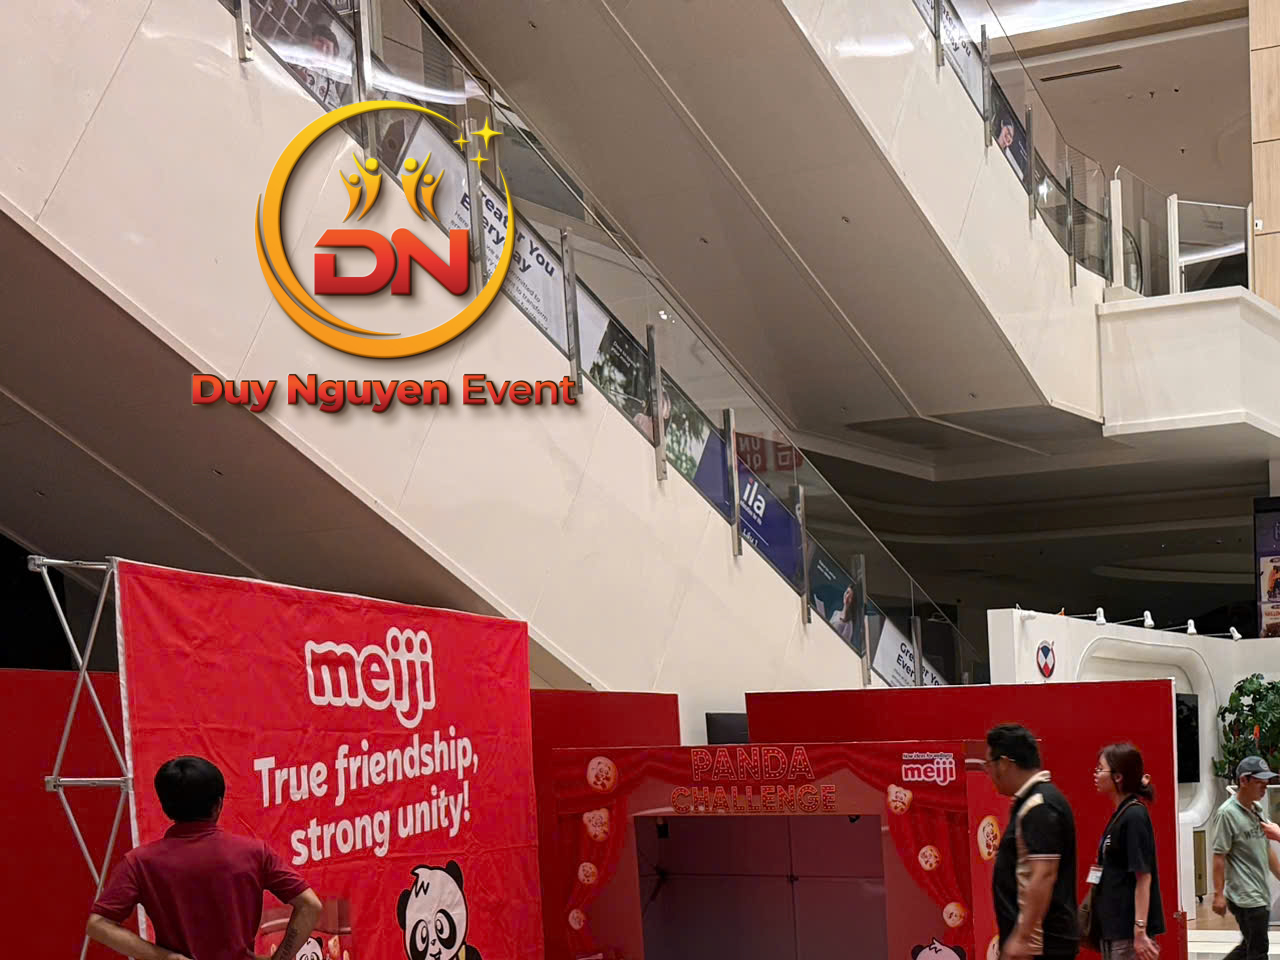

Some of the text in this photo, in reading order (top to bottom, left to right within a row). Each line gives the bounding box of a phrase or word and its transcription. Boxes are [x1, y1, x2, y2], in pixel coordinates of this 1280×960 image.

[528, 239, 556, 277] You
[742, 477, 767, 518] ila
[304, 626, 436, 729] meiji
[253, 725, 479, 808] True friendship,
[690, 746, 816, 781] PANDA
[902, 758, 957, 786] meiji
[671, 784, 836, 814] CHALLENGE
[290, 780, 471, 866] strong unity!
